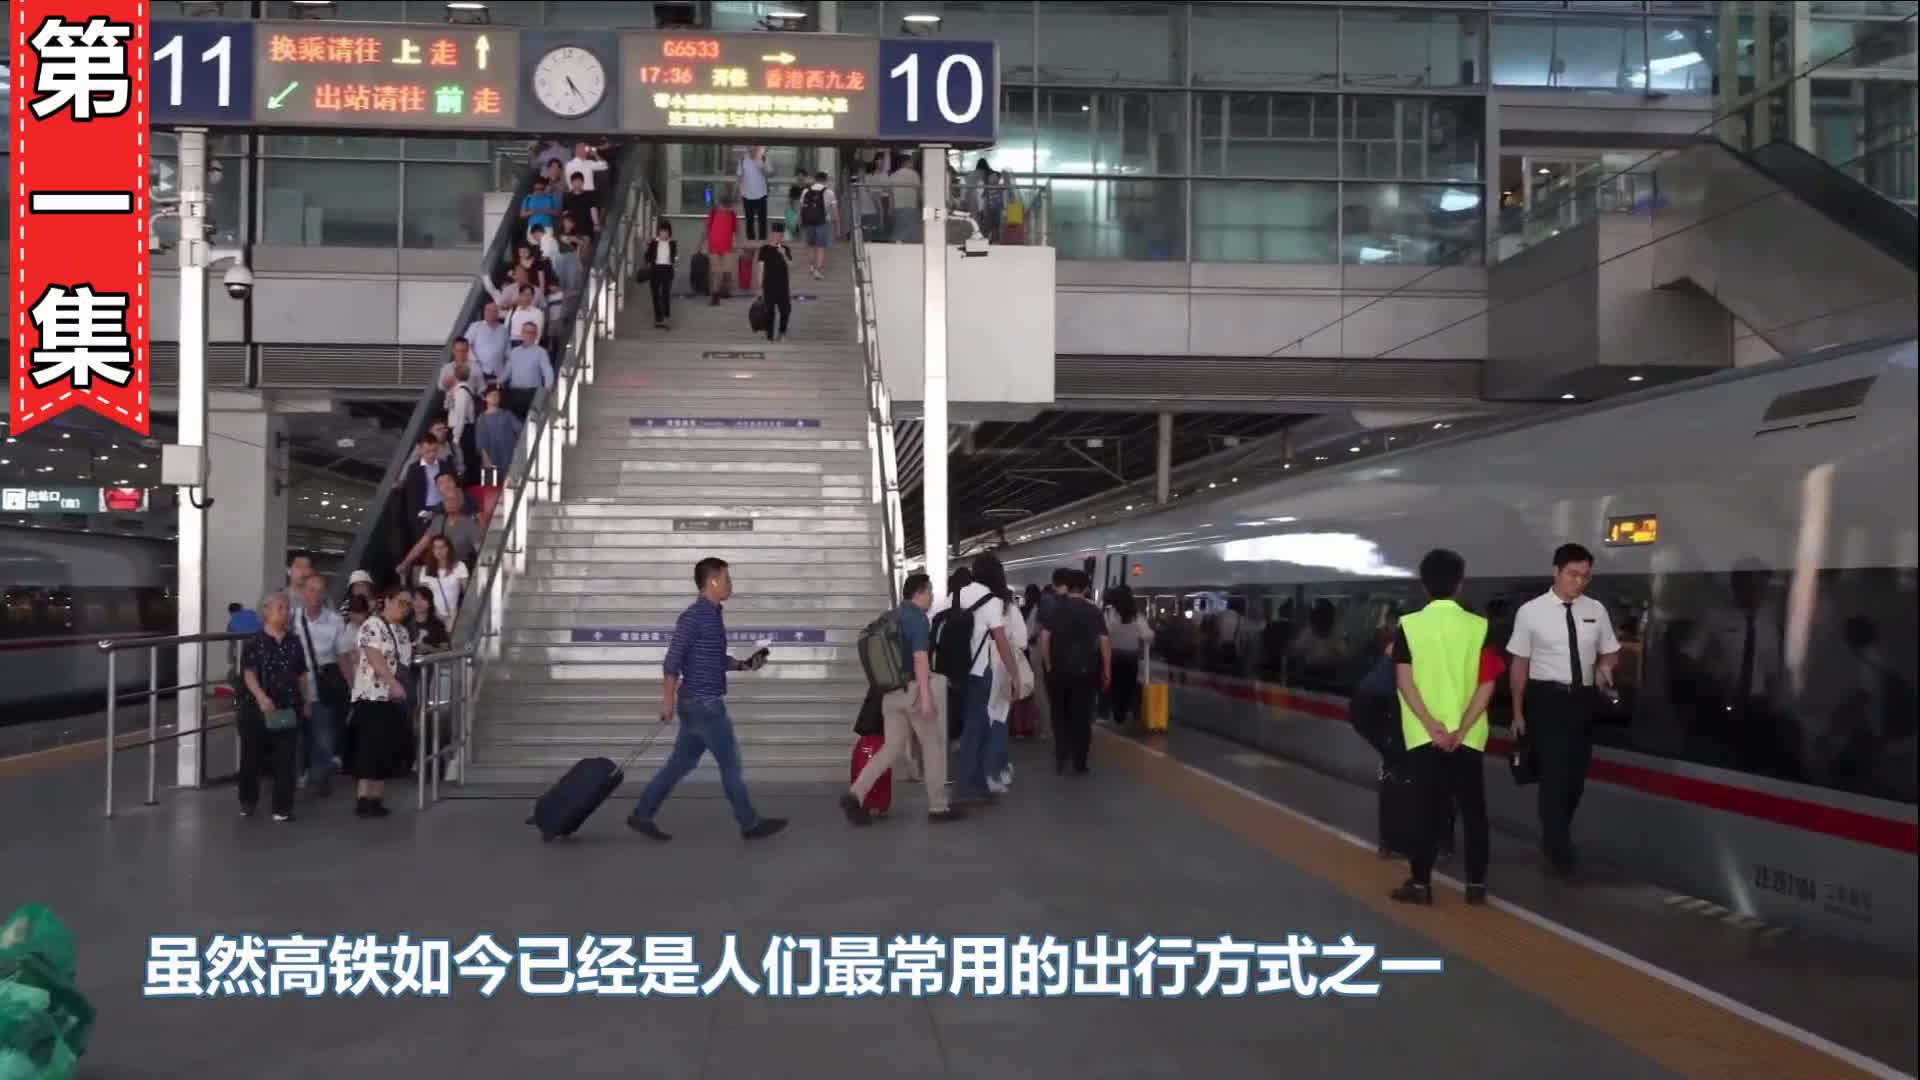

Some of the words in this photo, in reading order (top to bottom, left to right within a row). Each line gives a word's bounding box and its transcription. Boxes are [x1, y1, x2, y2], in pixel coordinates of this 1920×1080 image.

[269, 36, 381, 64] 换乘请往
[392, 39, 422, 65] 上
[430, 39, 458, 66] 走
[663, 40, 720, 58] G6533
[153, 35, 231, 107] 11
[640, 66, 693, 84] 17:36
[765, 69, 865, 90] 香港西九龙
[315, 85, 425, 112] 出站请往
[434, 86, 465, 114] 前
[472, 88, 502, 114] 走
[891, 53, 983, 124] 10
